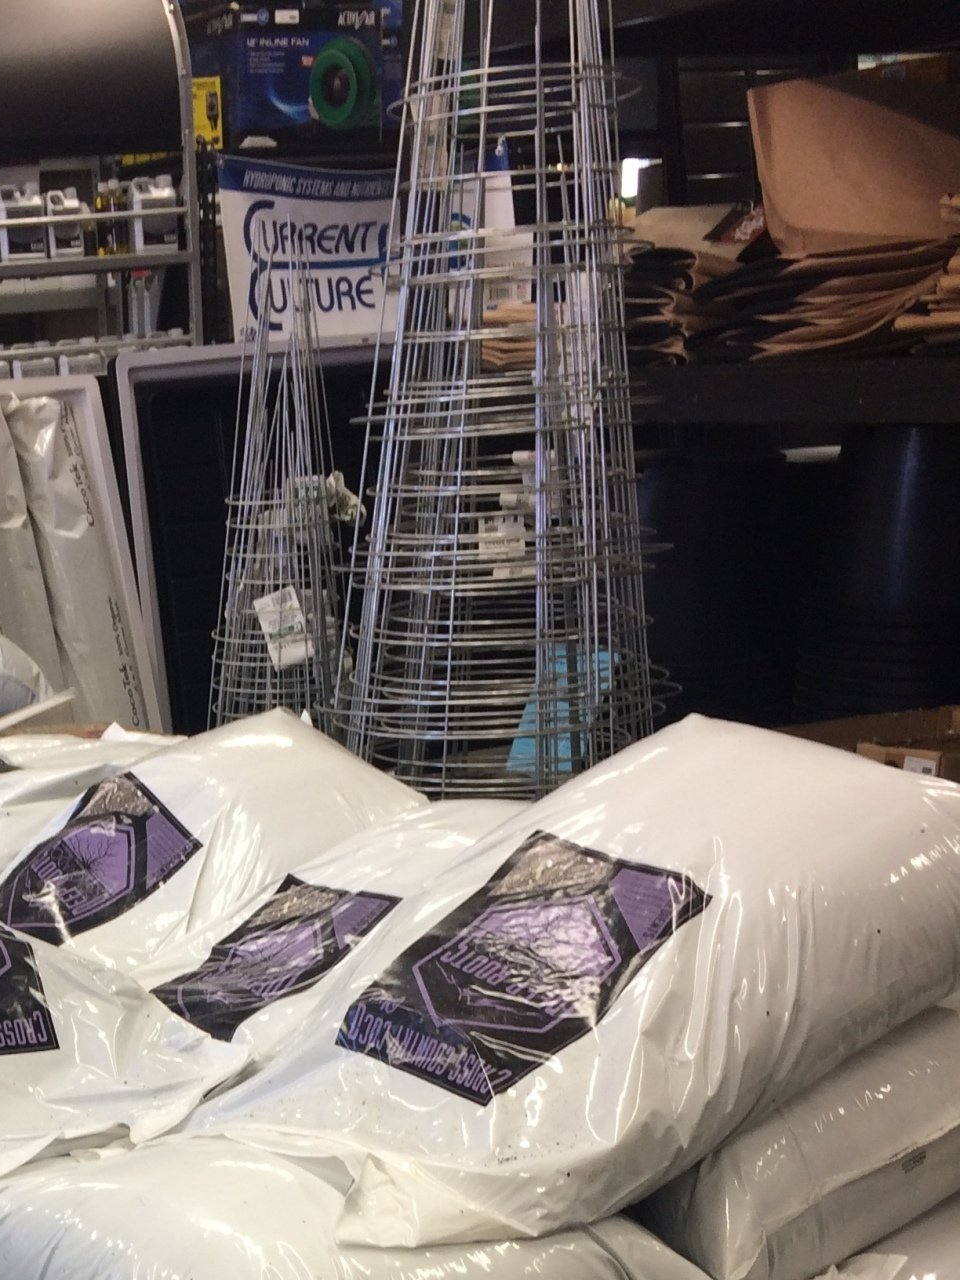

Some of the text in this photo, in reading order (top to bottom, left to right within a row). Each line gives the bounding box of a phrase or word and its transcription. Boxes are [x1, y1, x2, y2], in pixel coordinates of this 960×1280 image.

[290, 36, 310, 47] FAN
[242, 169, 297, 194] HYDROPONIC
[296, 176, 334, 197] SYSTEMS
[243, 200, 378, 265] CURRENT
[347, 1003, 513, 1094] CROSS COUNTRY COCO
